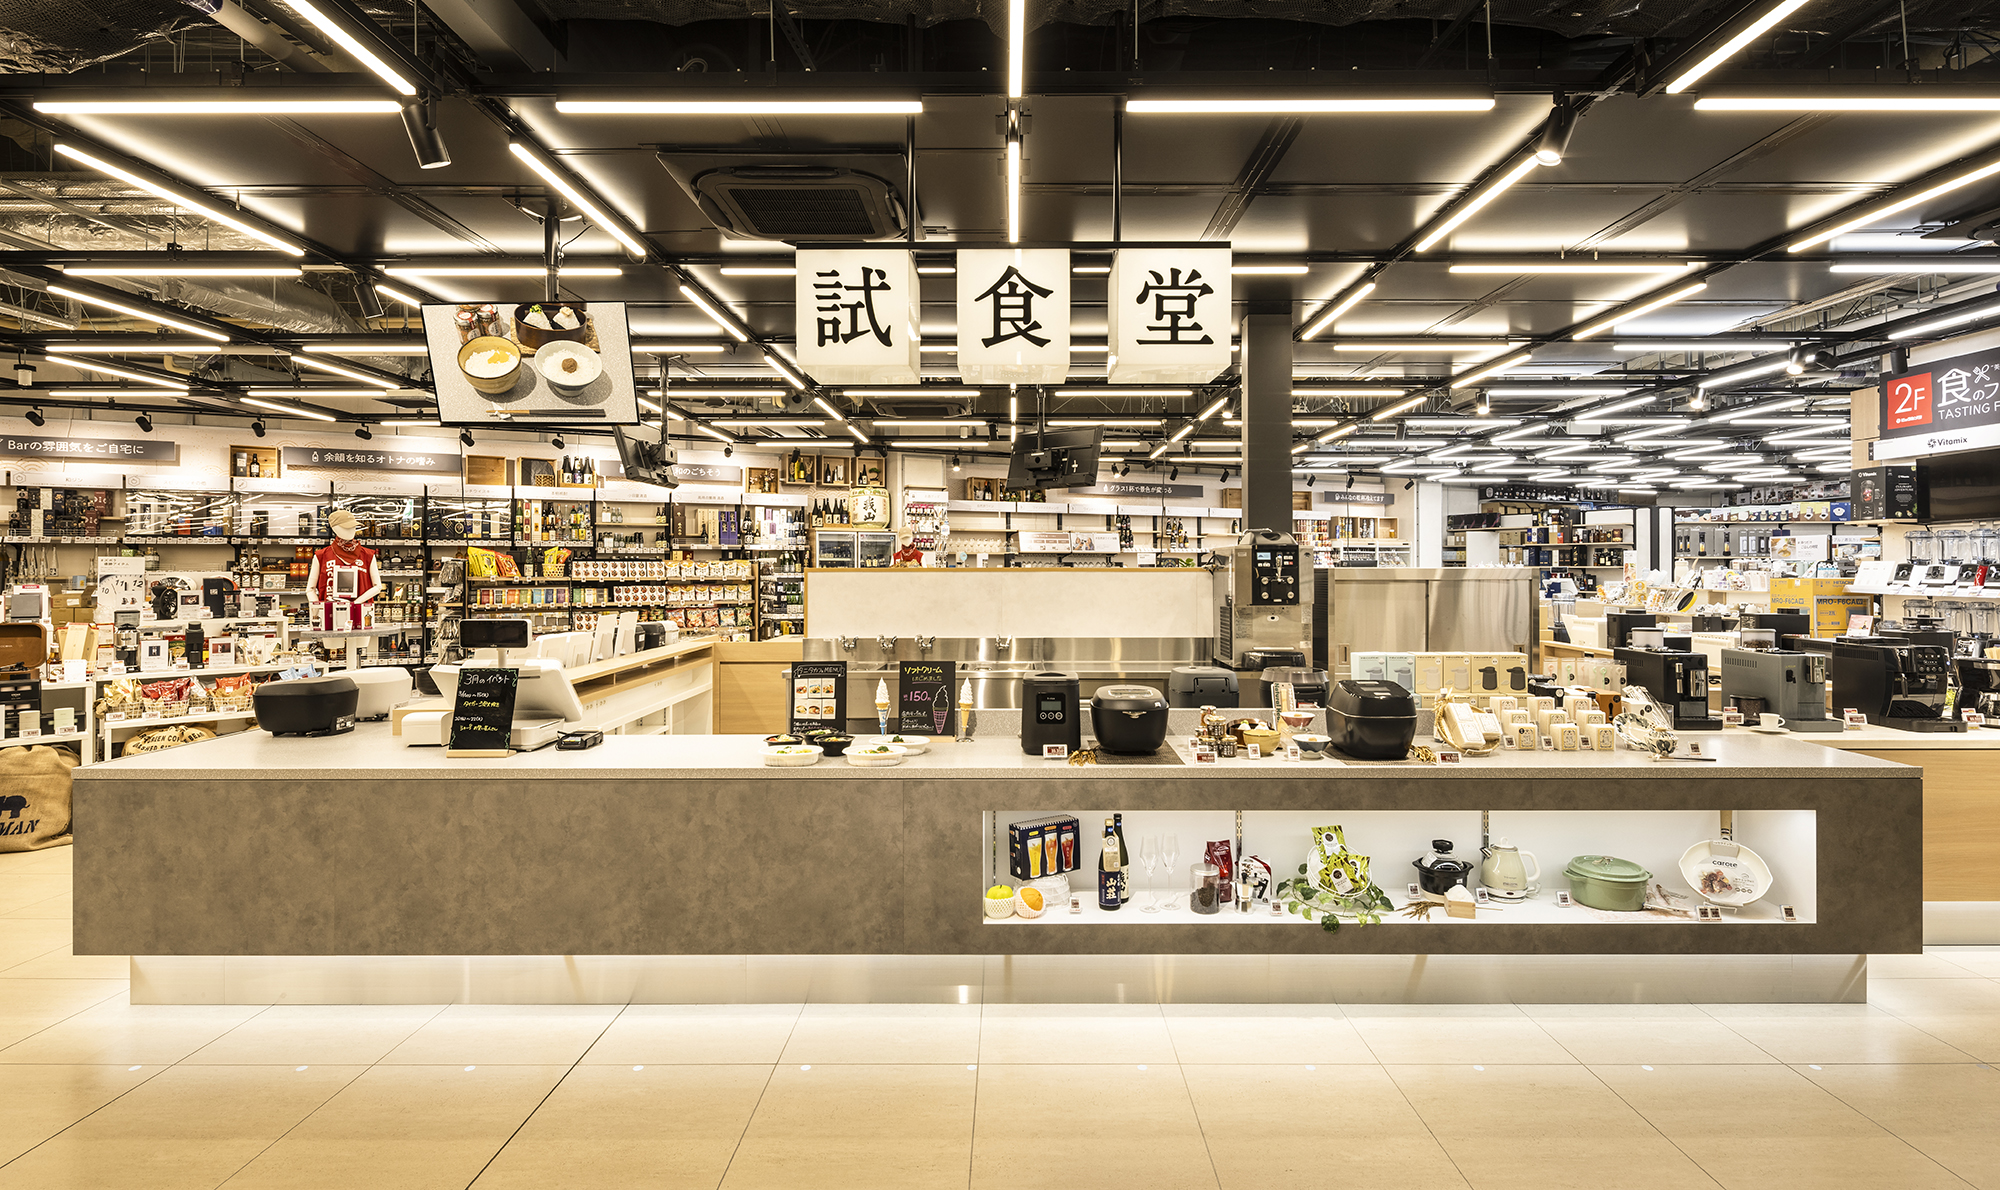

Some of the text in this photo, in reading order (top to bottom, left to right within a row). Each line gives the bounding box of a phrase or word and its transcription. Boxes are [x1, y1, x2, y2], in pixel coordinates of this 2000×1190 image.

[1894, 382, 1926, 414] 2F
[1937, 402, 1991, 420] TASTING
[8, 440, 144, 454] Barの雰囲気をご自宅に
[1937, 436, 1968, 446] Vitamix
[323, 452, 436, 466] 余韻を知るオトナの嗜み
[132, 580, 144, 588] 12
